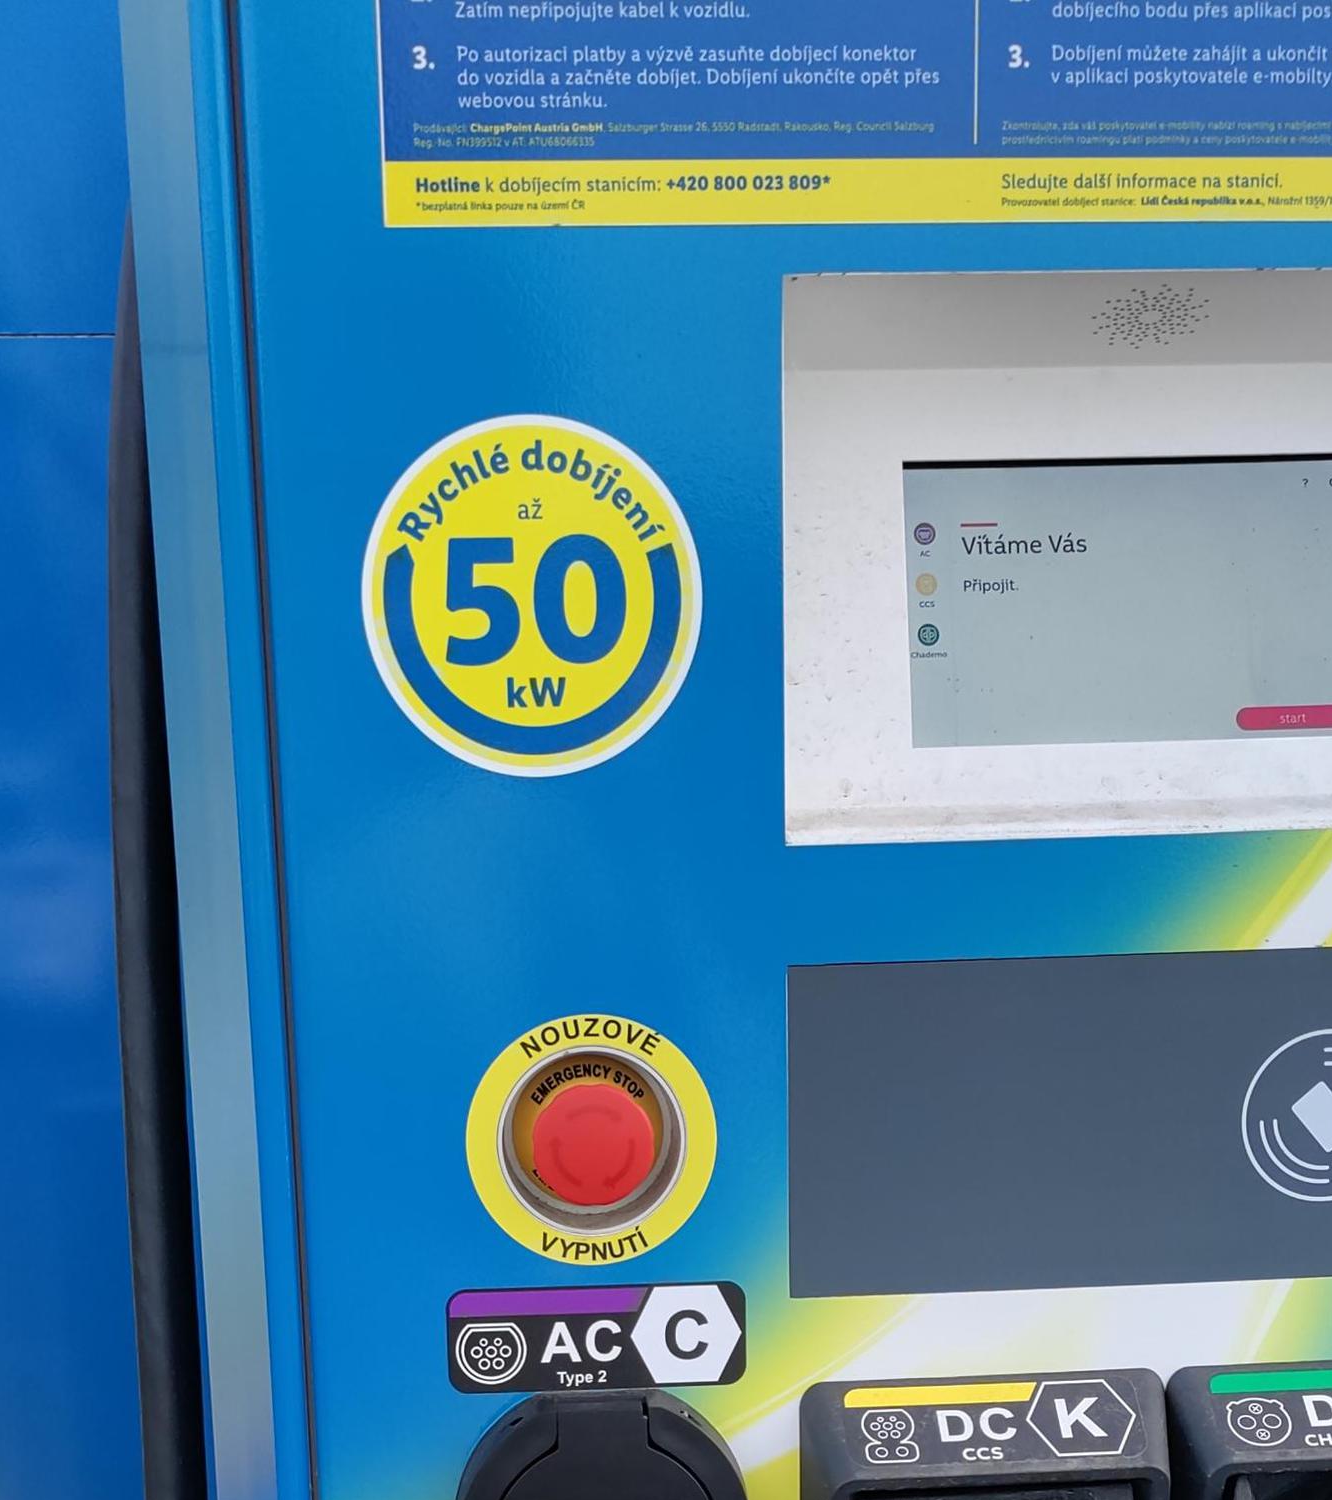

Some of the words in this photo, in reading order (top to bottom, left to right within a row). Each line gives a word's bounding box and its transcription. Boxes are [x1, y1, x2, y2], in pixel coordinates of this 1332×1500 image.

[455, 1, 503, 19] Zatím
[509, 1, 614, 22] nepřipojujte
[620, 1, 664, 18] kabel
[671, 1, 679, 18] k
[684, 1, 750, 18] vozidlu.
[1052, 1, 1138, 21] dobíjecího
[1146, 1, 1187, 18] bodu
[1193, 1, 1228, 21] přes
[1233, 1, 1296, 21] aplikaci
[412, 45, 436, 70] 3.
[457, 45, 479, 62] Po
[484, 45, 568, 62] autorizaci
[573, 45, 626, 66] platby
[631, 49, 641, 62] a
[646, 45, 694, 66] výzvě
[699, 45, 764, 62] zasuňte
[770, 44, 837, 66] dobíjecí
[842, 44, 917, 62] konektor
[1008, 44, 1030, 68] 3.
[1052, 44, 1121, 65] Dobíjení
[1128, 44, 1187, 61] můžete
[1193, 44, 1247, 65] zahájit
[1252, 49, 1262, 61] a
[1267, 45, 1327, 62] ukončit
[457, 68, 479, 86] do
[484, 68, 545, 86] vozidla
[550, 73, 560, 85] a
[565, 68, 631, 86] začněte
[637, 68, 701, 89] dobíjet.
[706, 67, 777, 89] Dobíjení
[783, 67, 855, 85] ukončíte
[860, 68, 899, 88] opět
[904, 67, 940, 88] přes
[1051, 71, 1059, 84] v
[1065, 67, 1129, 87] aplikaci
[1134, 67, 1247, 87] poskytovatele
[458, 91, 535, 109] webovou
[540, 90, 608, 109] stránku.
[469, 122, 532, 135] ChargePoint
[534, 122, 569, 133] Austria
[416, 177, 480, 193] Hotline
[485, 177, 493, 192] k
[500, 177, 581, 196] dobíjecím
[587, 176, 661, 192] stanicím:
[666, 176, 708, 191] +420
[714, 175, 747, 191] 800
[753, 175, 783, 190] 023
[1002, 173, 1068, 192] Sledujte
[1074, 173, 1111, 188] další
[1116, 172, 1196, 188] informace
[1203, 176, 1221, 188] na
[495, 201, 524, 212] pouze
[526, 202, 538, 210] na
[571, 199, 585, 210] ČR
[1001, 197, 1060, 208] Provozovatel
[1141, 196, 1159, 206] Lidl
[1162, 194, 1189, 206] Česká
[397, 443, 510, 541] Rychlé
[521, 439, 666, 542] dobíjení
[518, 498, 543, 520] až
[961, 534, 1042, 555] Vítáme
[1048, 532, 1087, 554] Vás
[446, 533, 627, 667] 50
[506, 676, 567, 709] kW
[1279, 713, 1307, 724] start
[519, 1017, 662, 1059] NOUZOVÉ
[530, 1063, 612, 1105] EMERGENCY
[612, 1070, 645, 1101] STOP
[540, 1226, 649, 1262] VYPNUTÍ
[540, 1319, 623, 1364] AC
[664, 1309, 709, 1360] C
[557, 1371, 594, 1387] Type
[597, 1370, 607, 1383] 2
[936, 1408, 1017, 1443] DC
[1053, 1396, 1109, 1439] K
[962, 1447, 1004, 1461] CCS
